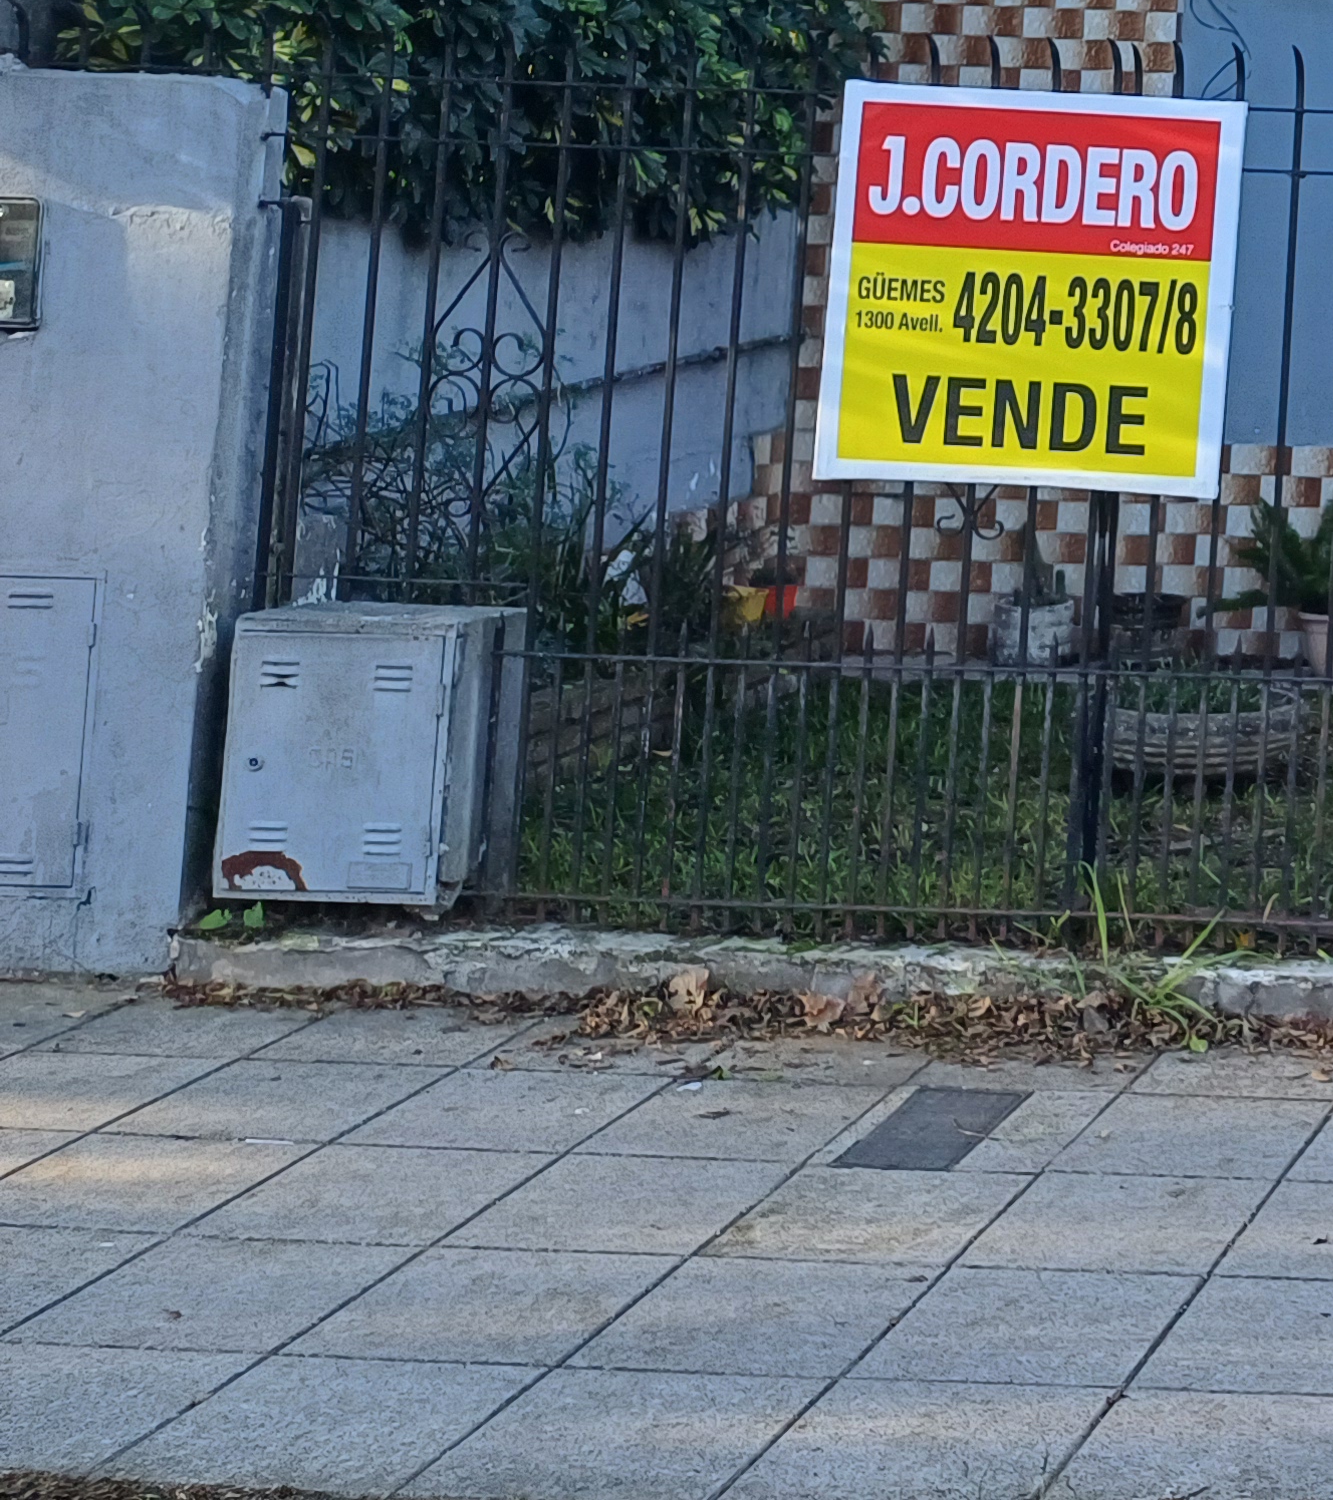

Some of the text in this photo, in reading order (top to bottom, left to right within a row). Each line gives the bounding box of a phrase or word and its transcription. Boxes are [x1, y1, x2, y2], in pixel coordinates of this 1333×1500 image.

[867, 135, 1199, 231] J.CORDERO
[1110, 239, 1195, 256] Colegiado 247
[857, 271, 946, 303] GÜEMES
[953, 271, 1198, 355] 4204-3307/8
[855, 310, 944, 333] 1300 Avell.
[891, 372, 1149, 456] VENDE
